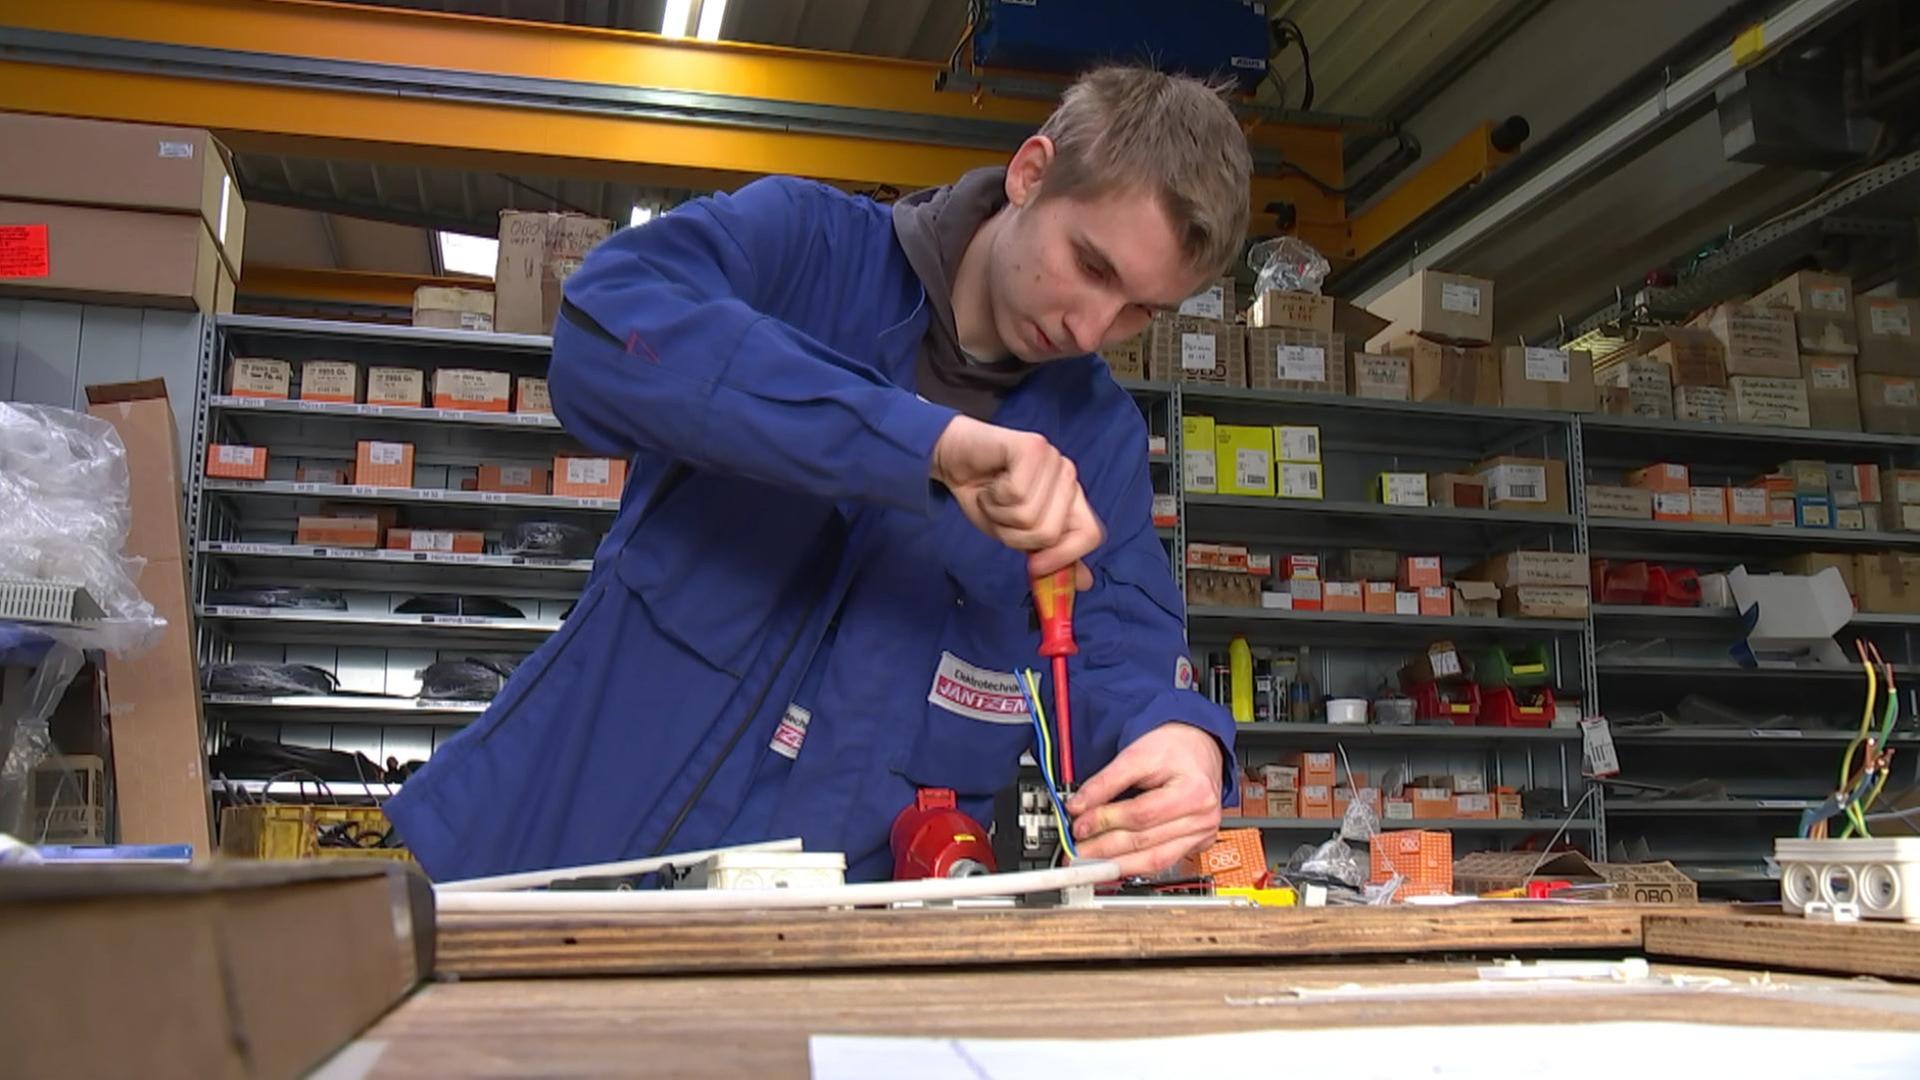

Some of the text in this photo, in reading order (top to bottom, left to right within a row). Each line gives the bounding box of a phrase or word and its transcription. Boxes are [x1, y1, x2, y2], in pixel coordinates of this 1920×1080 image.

[940, 681, 1029, 713] JANTZEN
[1208, 849, 1242, 869] OBO
[1635, 888, 1673, 903] OBO
